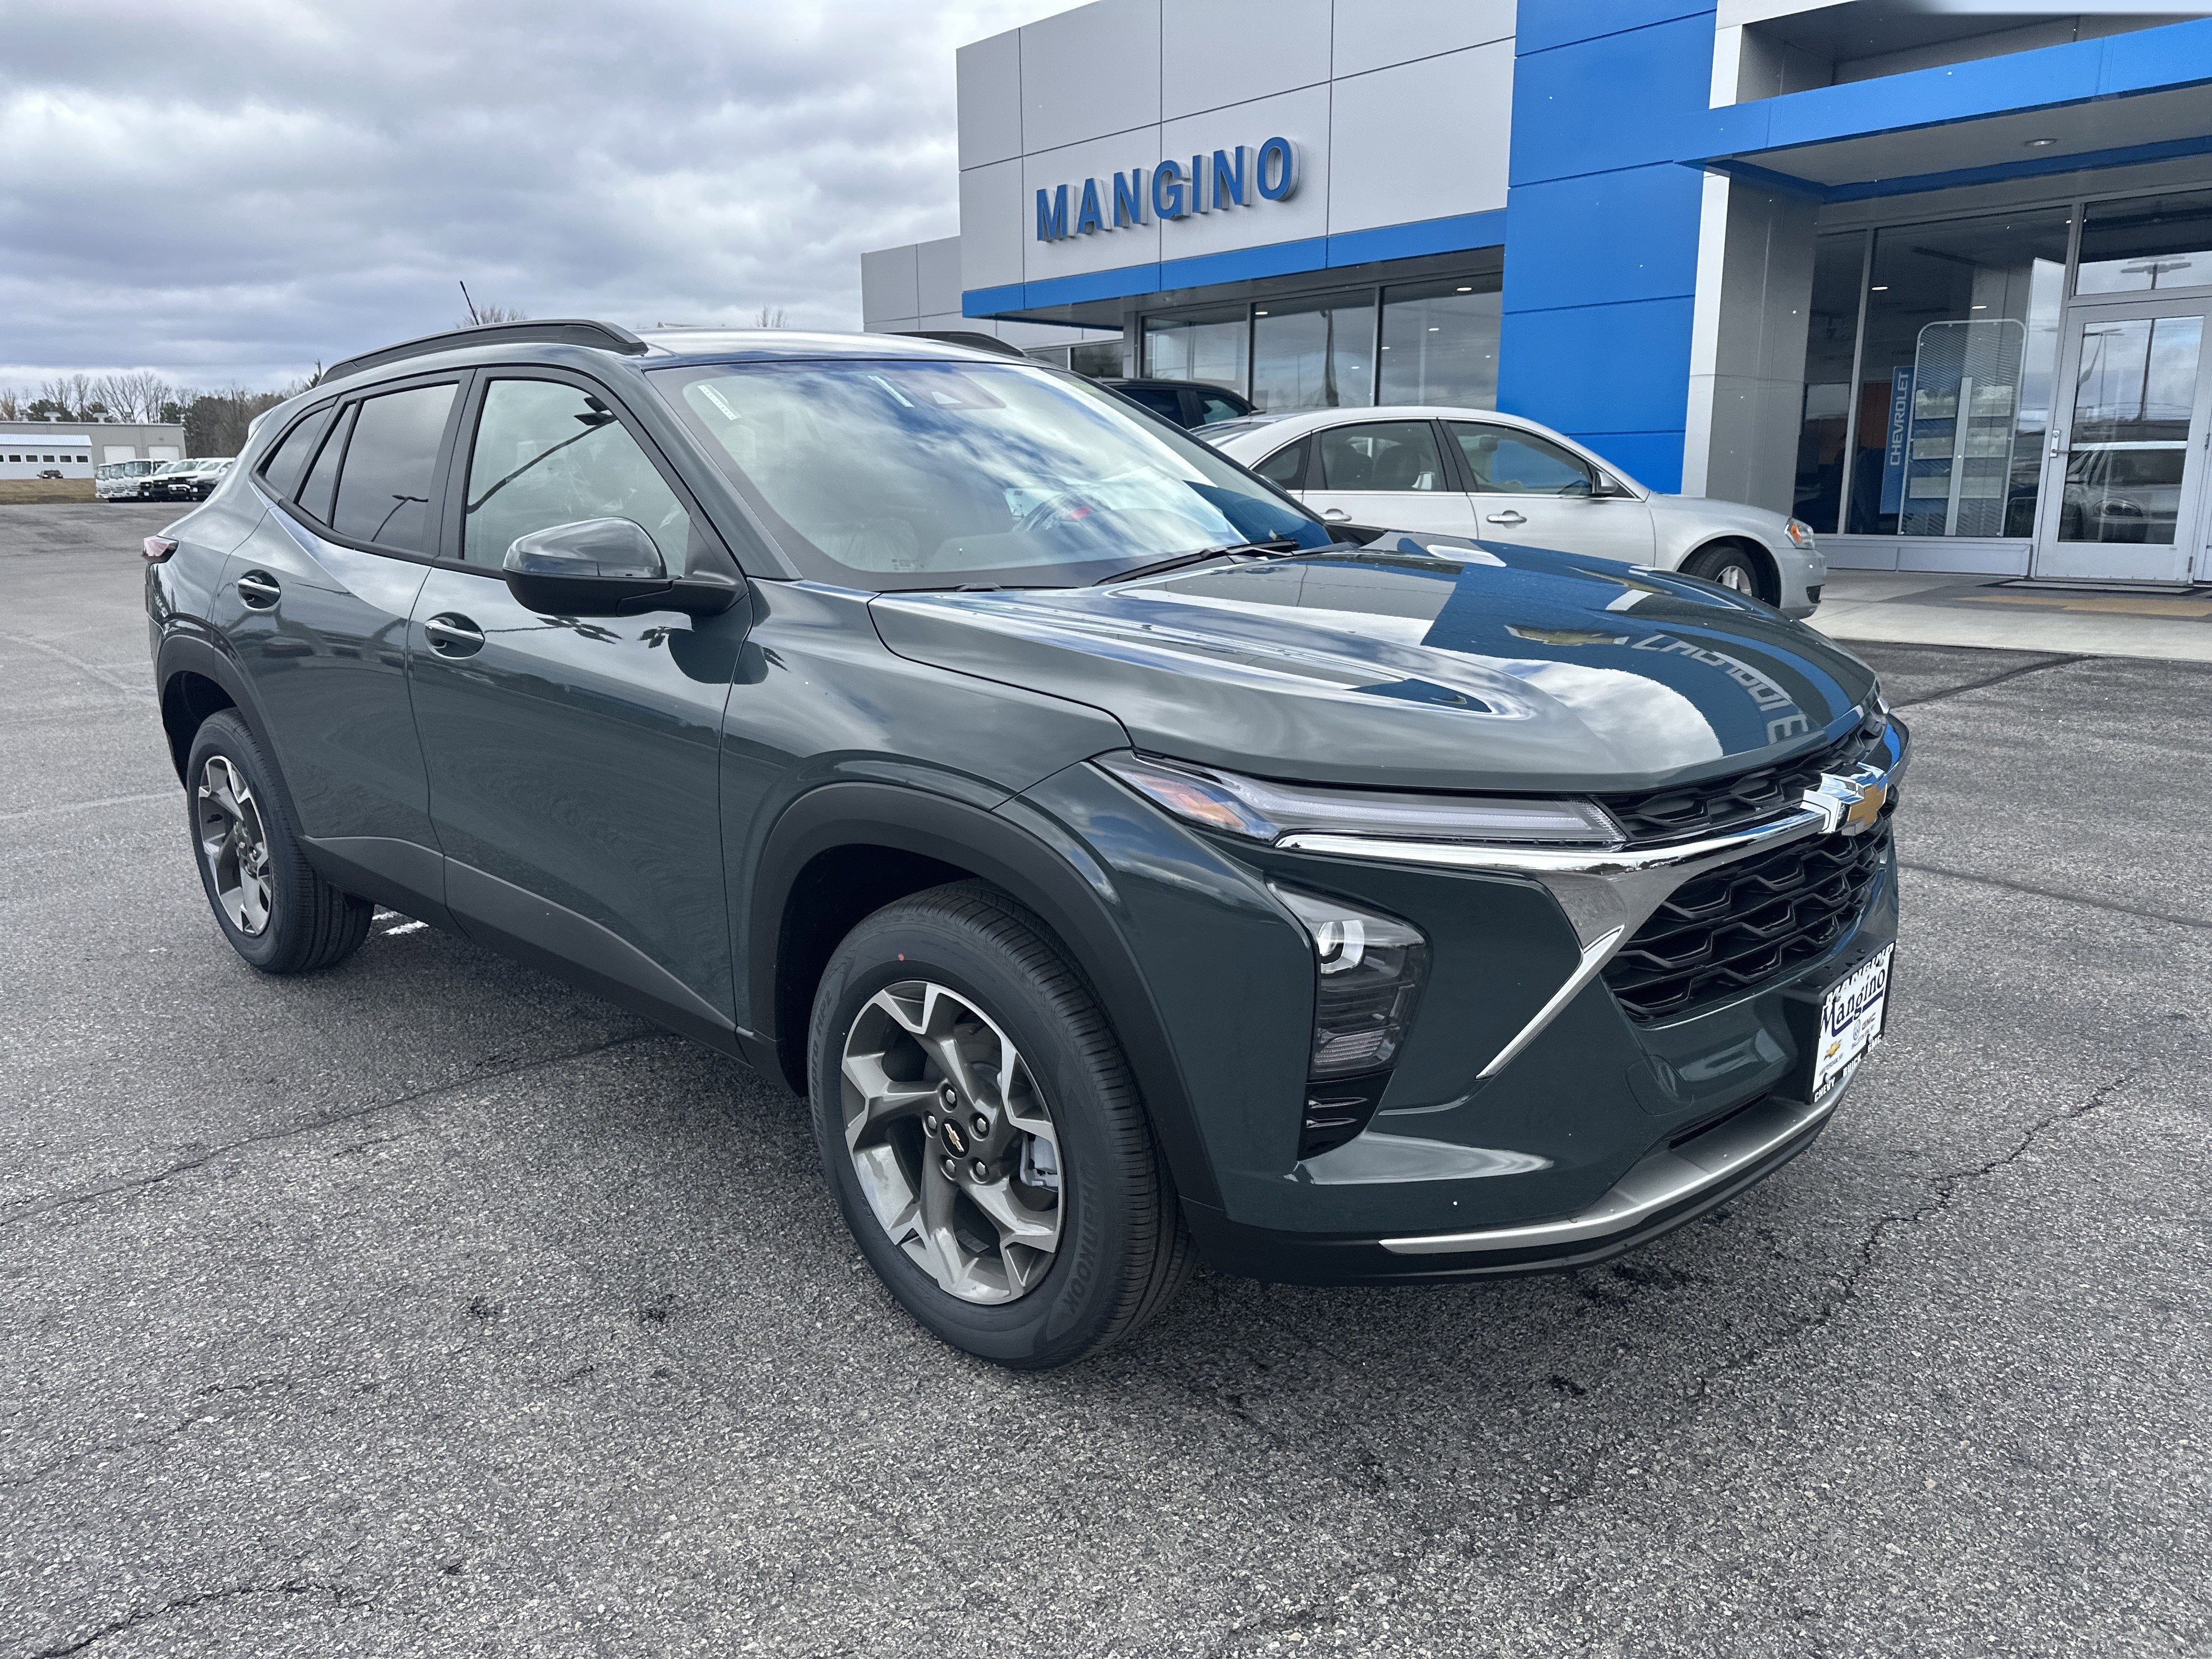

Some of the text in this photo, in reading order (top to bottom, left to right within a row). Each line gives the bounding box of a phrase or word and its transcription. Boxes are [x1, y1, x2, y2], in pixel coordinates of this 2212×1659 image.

[1036, 136, 1300, 242] MANGINO
[1889, 371, 1909, 466] CHEVROLET
[1821, 969, 1886, 1037] Mangino
[1862, 1012, 1876, 1030] GMC
[1814, 1034, 1882, 1102] CHEVY BUICK GMC
